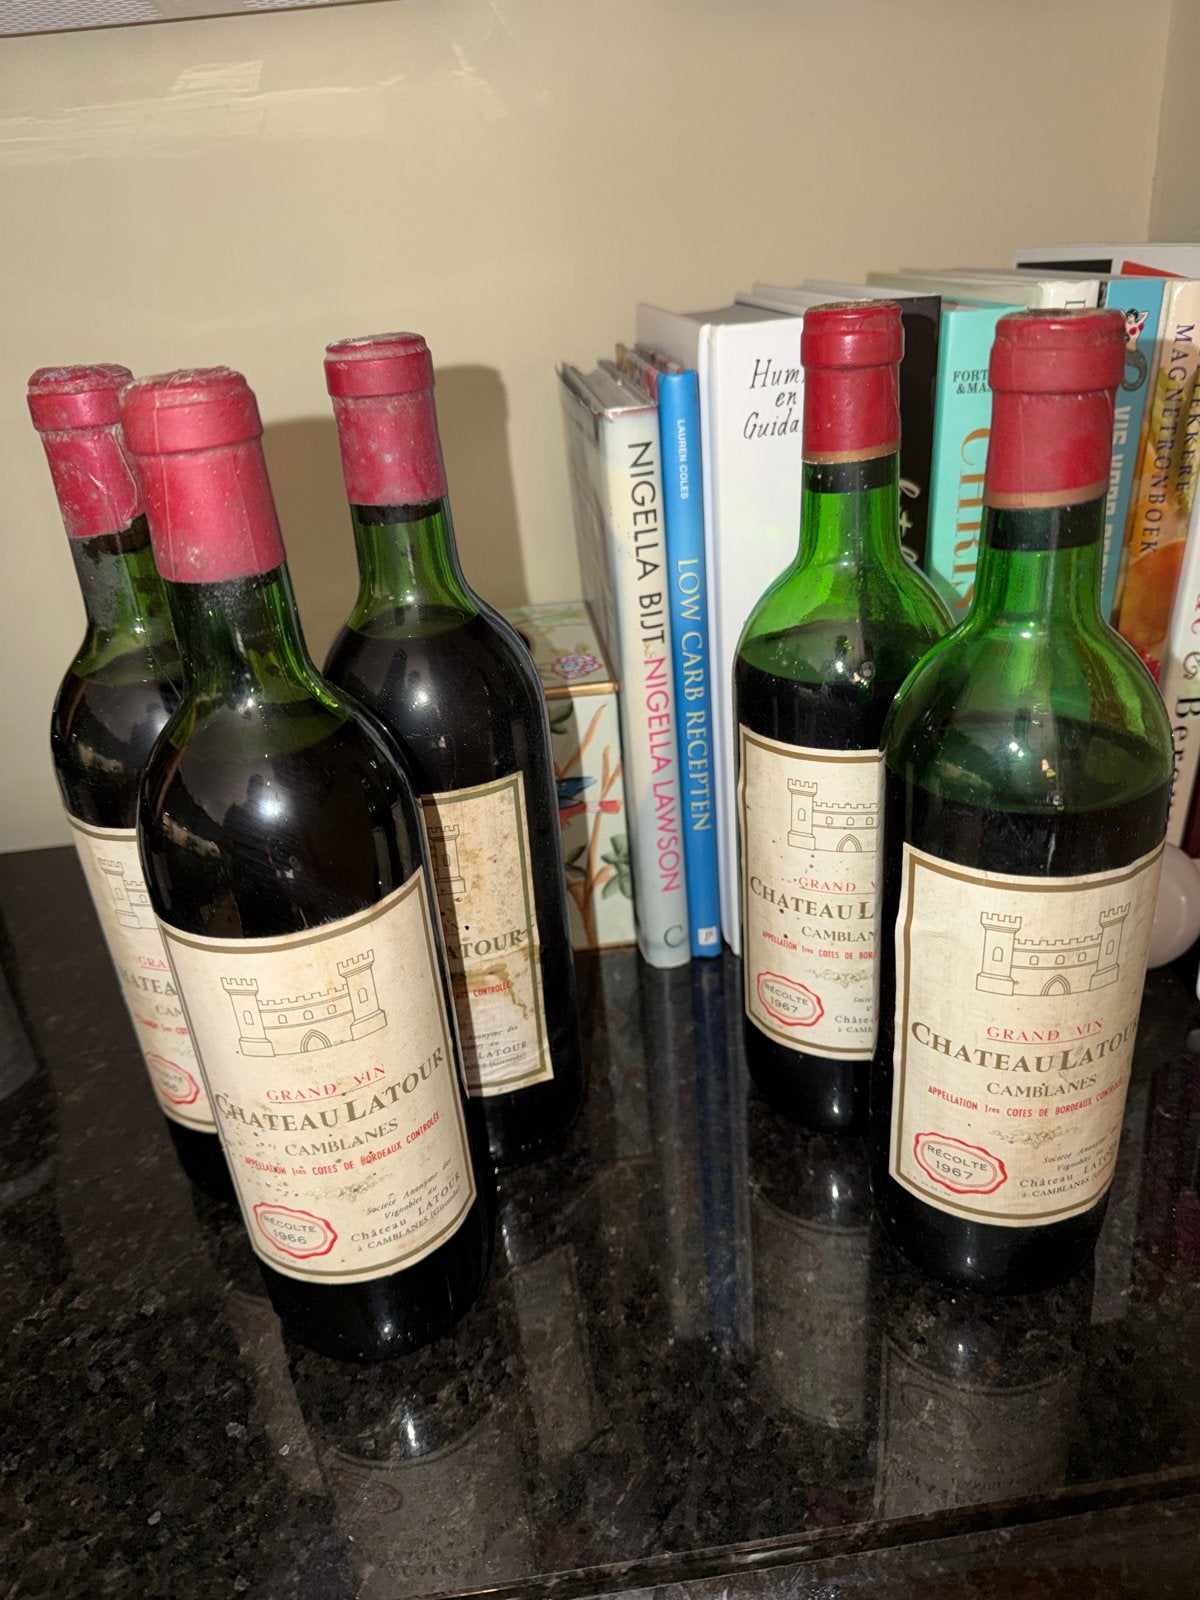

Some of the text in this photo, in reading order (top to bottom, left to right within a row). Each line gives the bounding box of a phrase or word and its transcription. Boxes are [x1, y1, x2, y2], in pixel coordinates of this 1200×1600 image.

[749, 359, 804, 389] Hum
[953, 370, 989, 382] FORT
[775, 392, 797, 408] en
[1141, 324, 1195, 554] MAGNETRONBOEK
[676, 419, 689, 500] LAUREN COLES
[628, 441, 660, 581] NIGELLA
[639, 592, 665, 643] BIJT
[677, 559, 711, 831] LOW CARB RECEPTEN
[644, 656, 670, 773] NIGELLA
[652, 782, 681, 893] LAWSON
[751, 876, 852, 920] CHATEAU
[799, 877, 856, 892] GRAND
[762, 930, 797, 950] APPELLATION
[819, 950, 839, 959] COTES
[770, 996, 798, 1013] 1967
[986, 1019, 1103, 1041] GRAND VIN
[479, 1041, 527, 1059] LATOUR
[911, 1021, 1054, 1073] CHATEAU
[214, 1047, 443, 1132] CHATEAU LATOUR
[266, 1064, 385, 1101] GRAND VIN
[986, 1073, 1097, 1098] CAMBLANES
[928, 1085, 978, 1110] APPELLATION
[1006, 1107, 1032, 1118] COTES
[1039, 1107, 1049, 1117] DE
[1055, 1097, 1092, 1116] BORDEAUX
[285, 1118, 398, 1156] CAMBLANES
[244, 1157, 287, 1175] APPELLATION
[312, 1162, 338, 1176] COTES
[344, 1161, 354, 1170] DE
[360, 1141, 402, 1165] BORDEAUX
[927, 1145, 988, 1172] RÉCOLTE
[935, 1160, 974, 1180] 1967
[403, 1172, 438, 1199] Anonyme
[1019, 1174, 1073, 1187] Château
[1032, 1177, 1089, 1197] CAMBLANES
[351, 1172, 460, 1242] Château LATOUR
[273, 1229, 307, 1245] 1966
[367, 1216, 429, 1249] CAMBLANES
